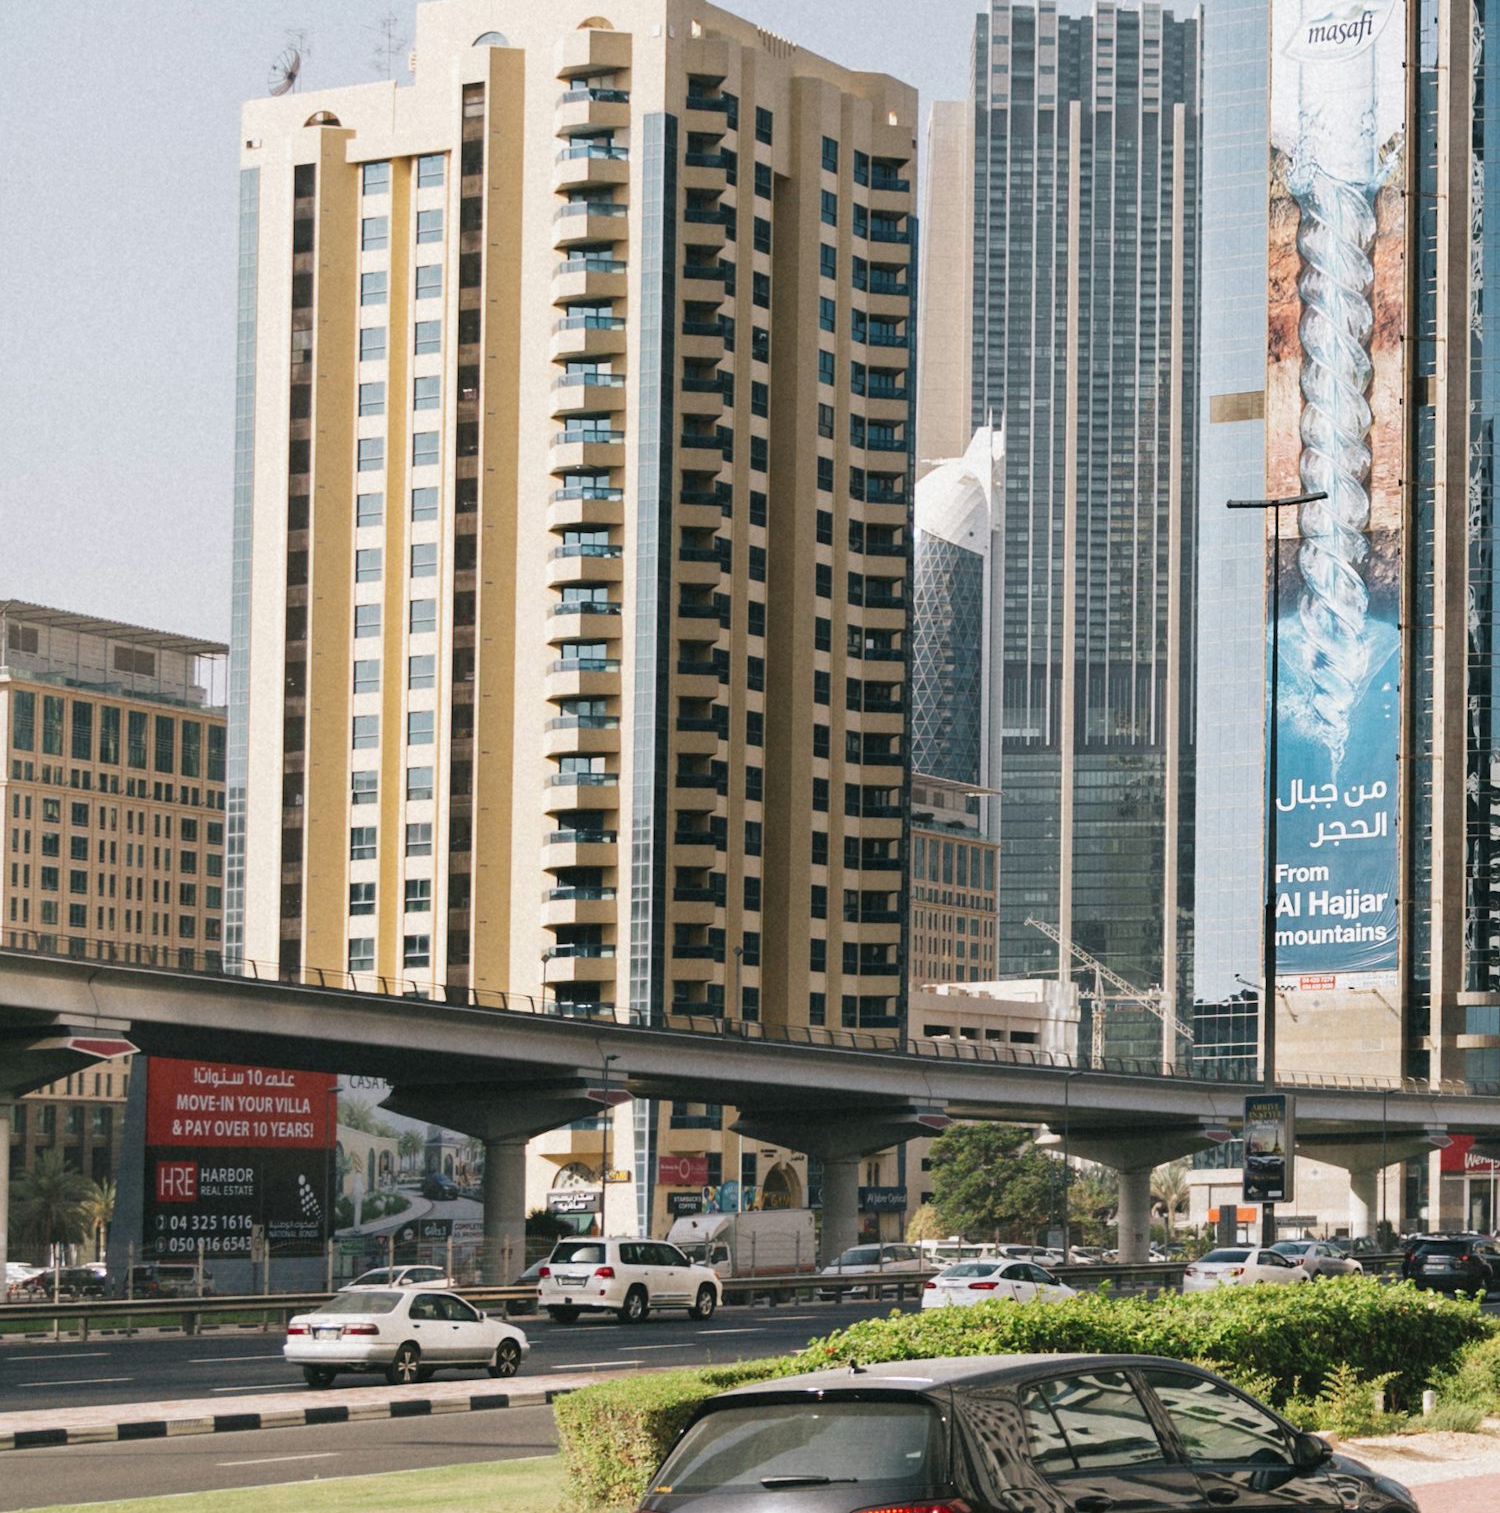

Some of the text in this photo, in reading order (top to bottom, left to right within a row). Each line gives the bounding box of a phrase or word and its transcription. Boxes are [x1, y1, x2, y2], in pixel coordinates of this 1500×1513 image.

[1308, 10, 1373, 46] masafi
[1275, 778, 1388, 812] من جبال
[1309, 811, 1388, 848] الحجر
[1275, 863, 1330, 884] From
[1275, 888, 1389, 920] Al Hajjar
[1275, 922, 1388, 946] mountains
[248, 1069, 263, 1086] 10
[265, 1070, 295, 1087] على
[350, 1075, 379, 1089] CASA
[176, 1094, 311, 1114] MOVE-IN YOUR VILLA
[172, 1119, 314, 1138] & PAY OVER 10 YEARS!
[161, 1167, 194, 1196] HRE
[201, 1167, 254, 1183] HARBOR
[200, 1185, 254, 1196] REAL ESTATE
[170, 1214, 253, 1230] 04 325 1616
[169, 1237, 195, 1252] 050
[198, 1236, 220, 1252] 16
